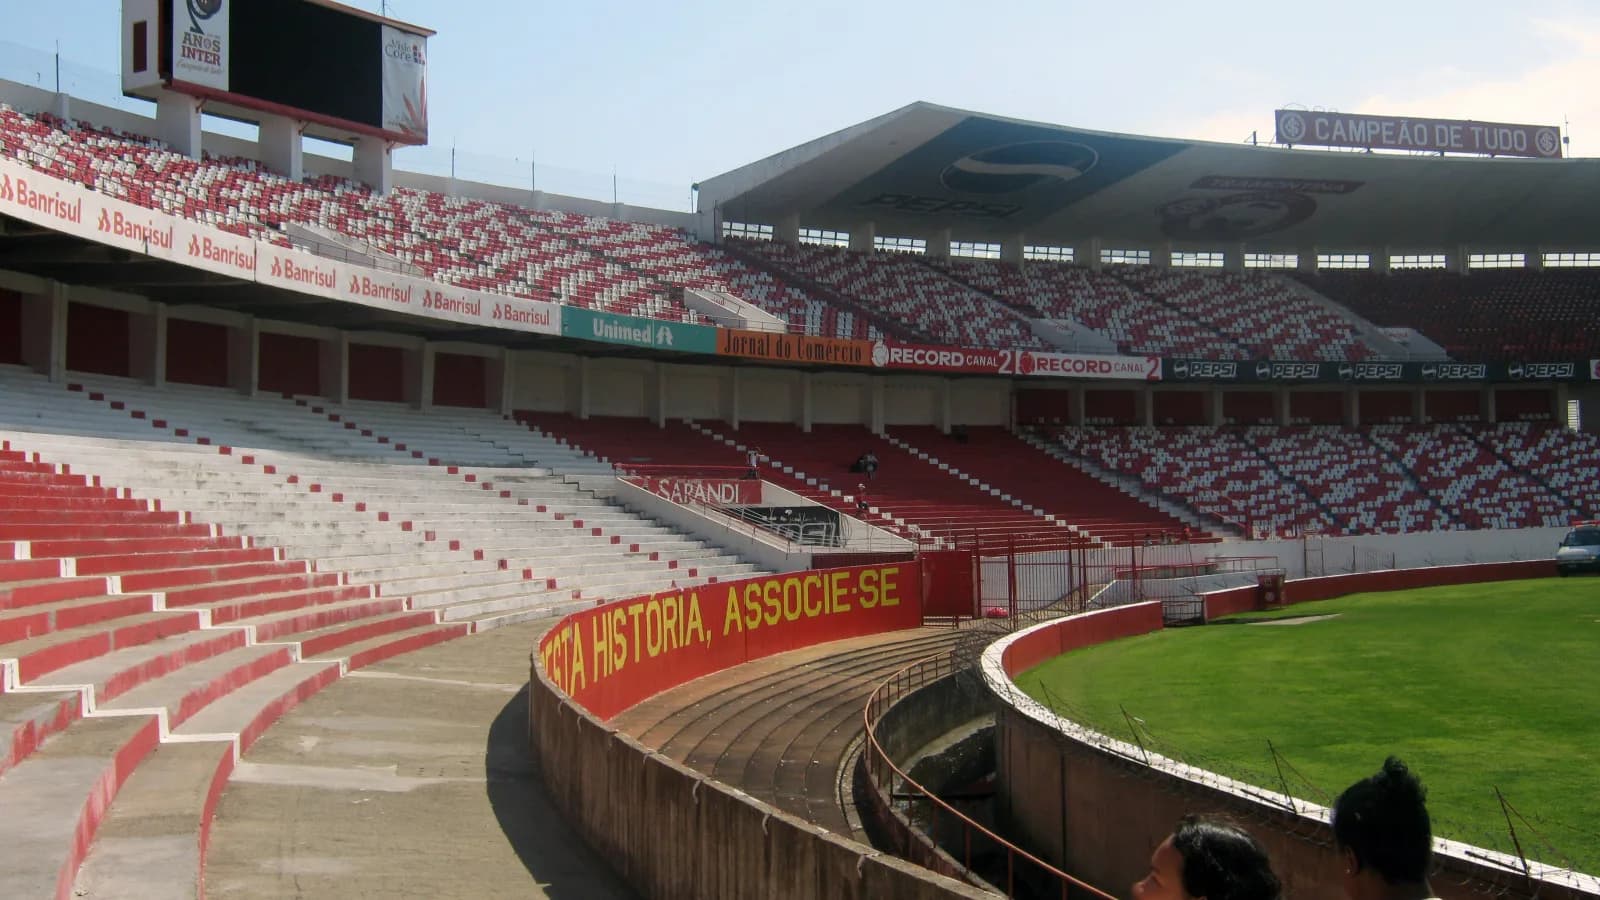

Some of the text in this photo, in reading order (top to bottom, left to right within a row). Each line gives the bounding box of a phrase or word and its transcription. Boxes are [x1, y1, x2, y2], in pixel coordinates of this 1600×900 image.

[181, 45, 221, 66] INTER
[1315, 117, 1527, 151] CAMPEÃO DE TUDO
[17, 179, 81, 223] Banrisul
[113, 211, 173, 249] Banrisul
[202, 236, 257, 270] Banrisul
[284, 259, 336, 289] Banrisul
[362, 276, 411, 304] Banrisul
[434, 292, 481, 316] Banrisul
[504, 304, 550, 326] Banrisul
[593, 318, 652, 343] Unimed
[723, 329, 862, 362] Jornal do Comércio
[890, 348, 1013, 374] RECORD CANAL 2
[1036, 356, 1160, 381] RECORD CANAL 2
[1190, 361, 1238, 378] PEPSI
[1272, 362, 1320, 379] PEPSI
[1354, 363, 1403, 379] PEPSI
[1437, 363, 1486, 379] PEPSI
[1525, 362, 1574, 378] PEPSI
[657, 479, 740, 504] SARANDI
